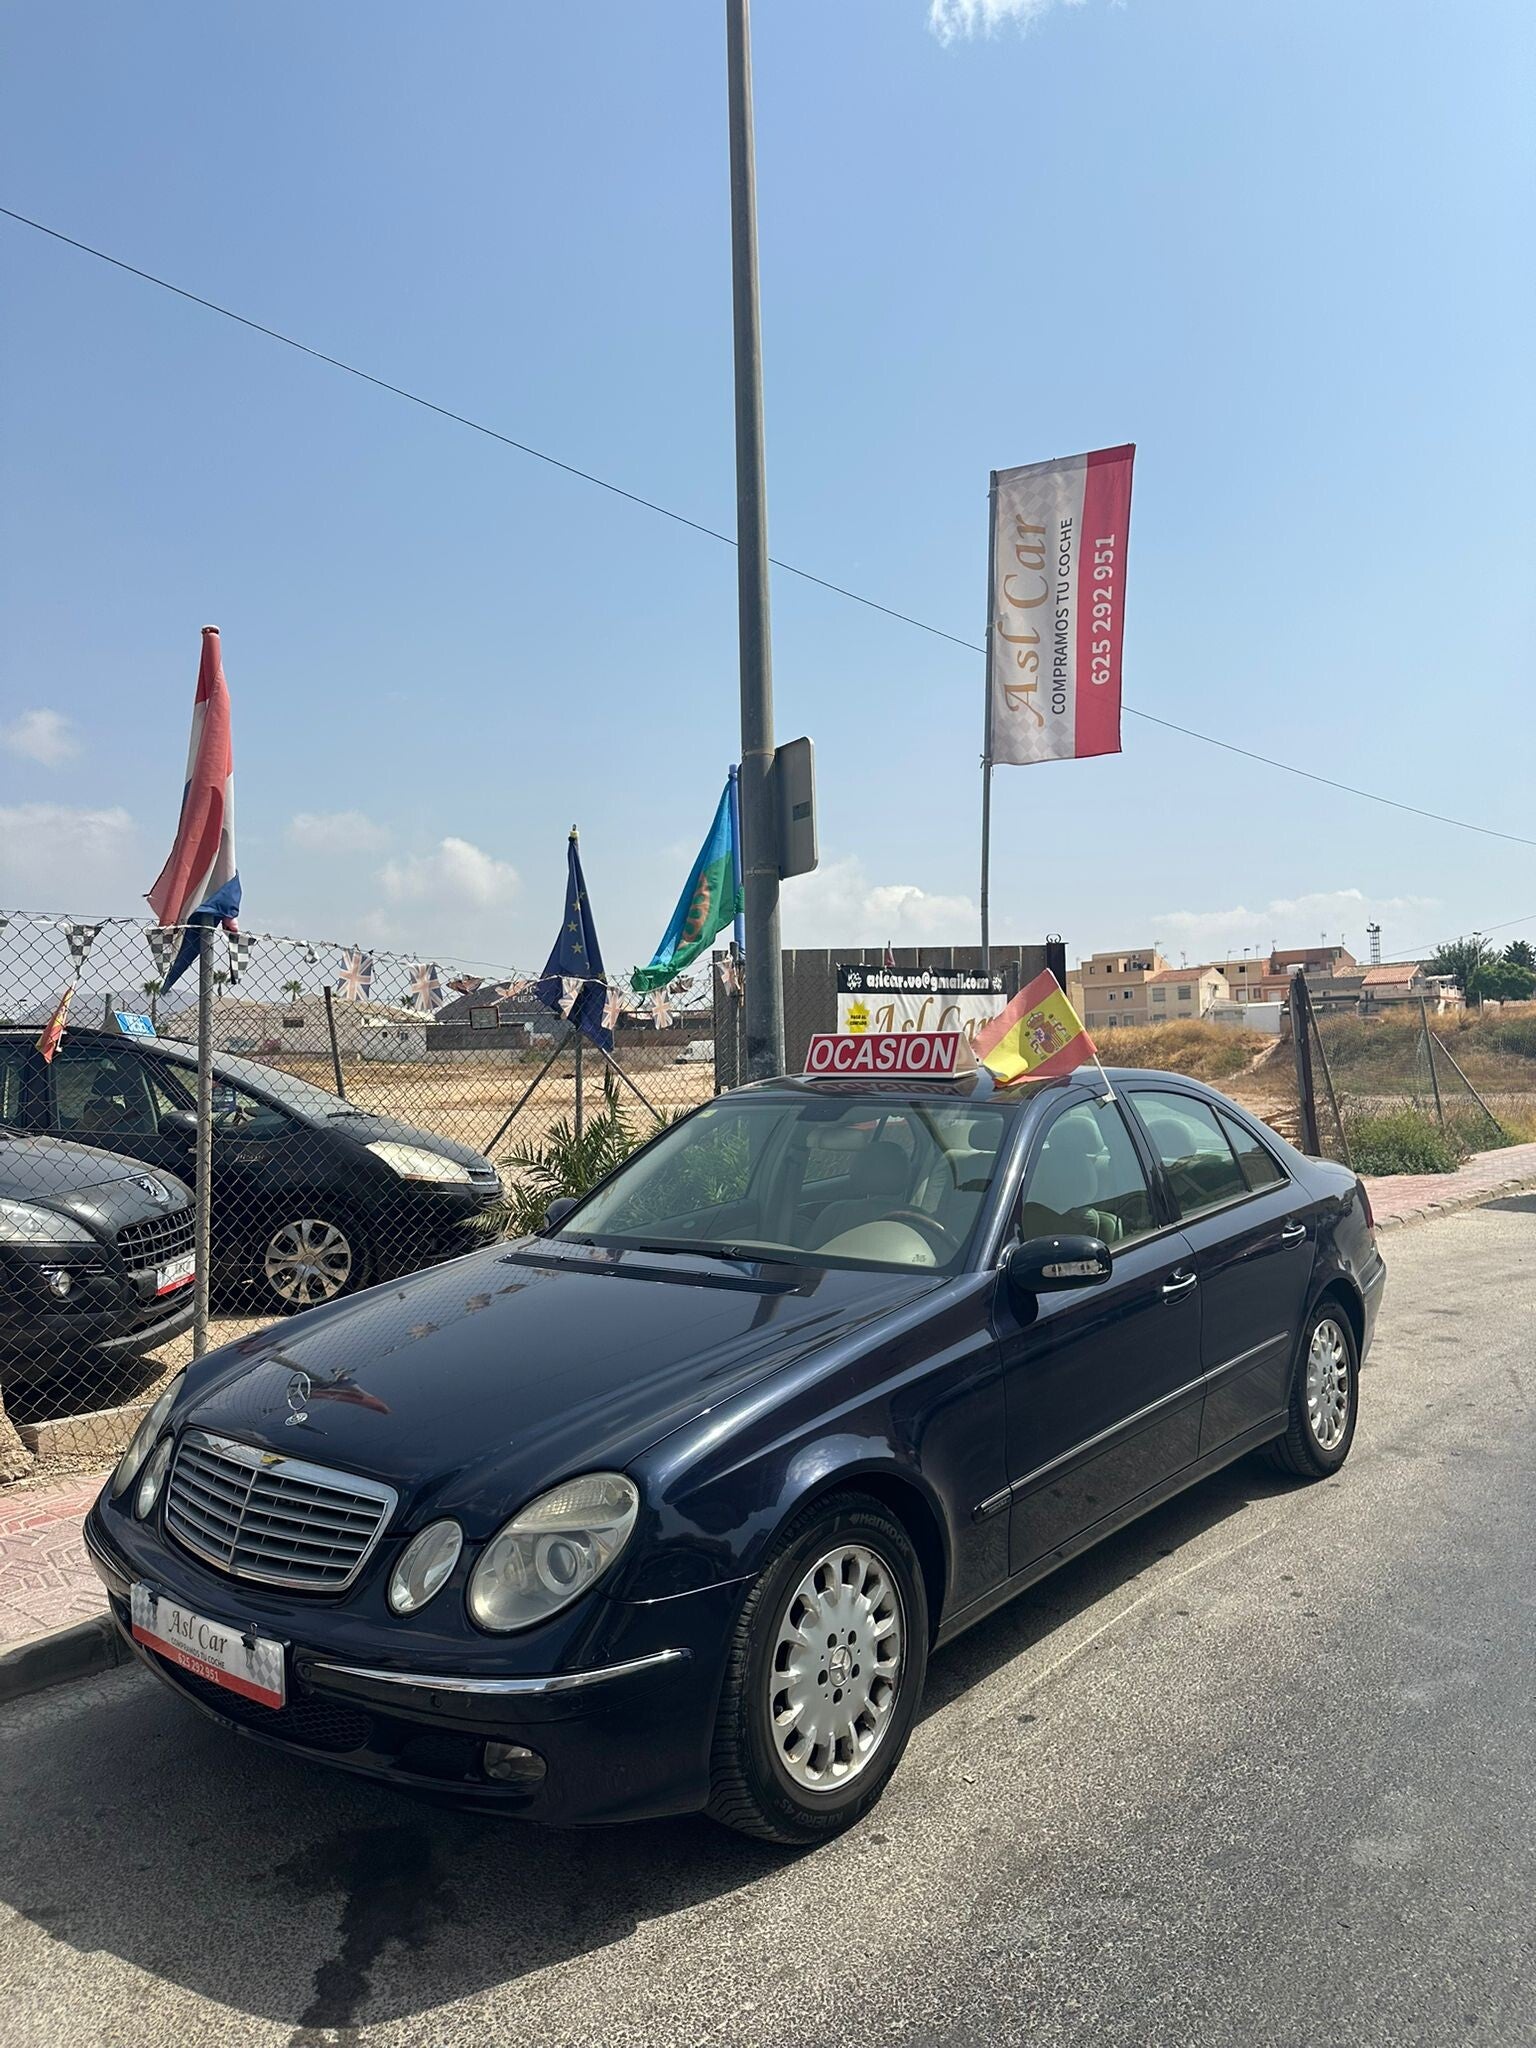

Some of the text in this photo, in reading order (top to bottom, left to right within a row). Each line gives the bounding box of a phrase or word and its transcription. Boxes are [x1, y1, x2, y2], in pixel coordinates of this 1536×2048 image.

[1003, 513, 1049, 609] Car
[1051, 517, 1073, 715] COMPRAMOS TU COCHE
[1091, 533, 1115, 686] 625 292 951
[811, 1037, 955, 1071] OCASION
[168, 1610, 228, 1653] Asl Car
[177, 1653, 220, 1683] 625 292 951
[207, 1656, 225, 1669] COCHE
